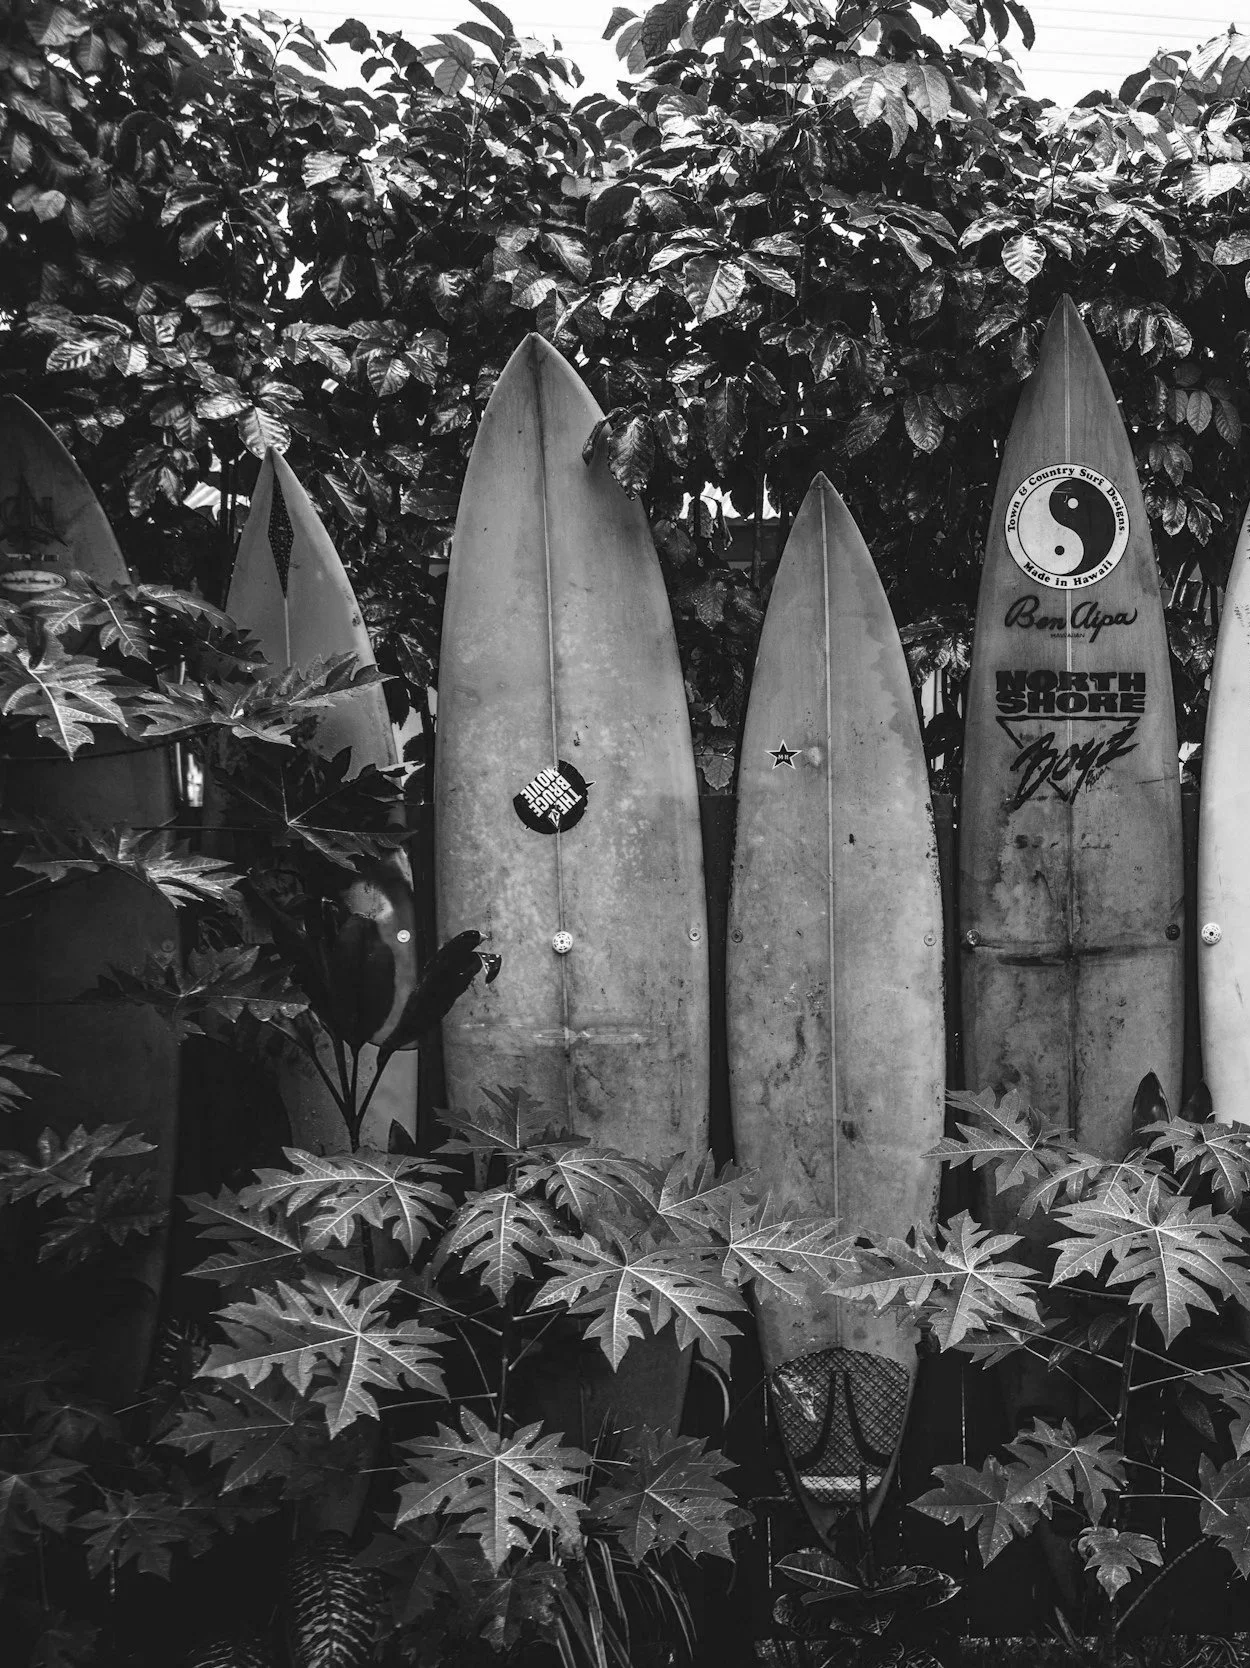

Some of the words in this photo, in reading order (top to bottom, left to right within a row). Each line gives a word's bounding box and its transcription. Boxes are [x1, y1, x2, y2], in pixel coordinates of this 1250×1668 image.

[1008, 501, 1021, 532] Town
[1019, 486, 1028, 496] &
[1028, 467, 1075, 486] Country
[1080, 468, 1105, 486] Surf
[1106, 487, 1125, 532] Designs
[1023, 562, 1051, 583] Made
[1055, 578, 1068, 587] in
[1073, 560, 1123, 586] Hawaii
[1004, 594, 1067, 629] Ben
[996, 670, 1146, 692] NORTH
[996, 691, 1146, 714] SHORE
[519, 767, 560, 804] MOVIE
[528, 774, 572, 818] BRUCE
[554, 787, 583, 816] THE
